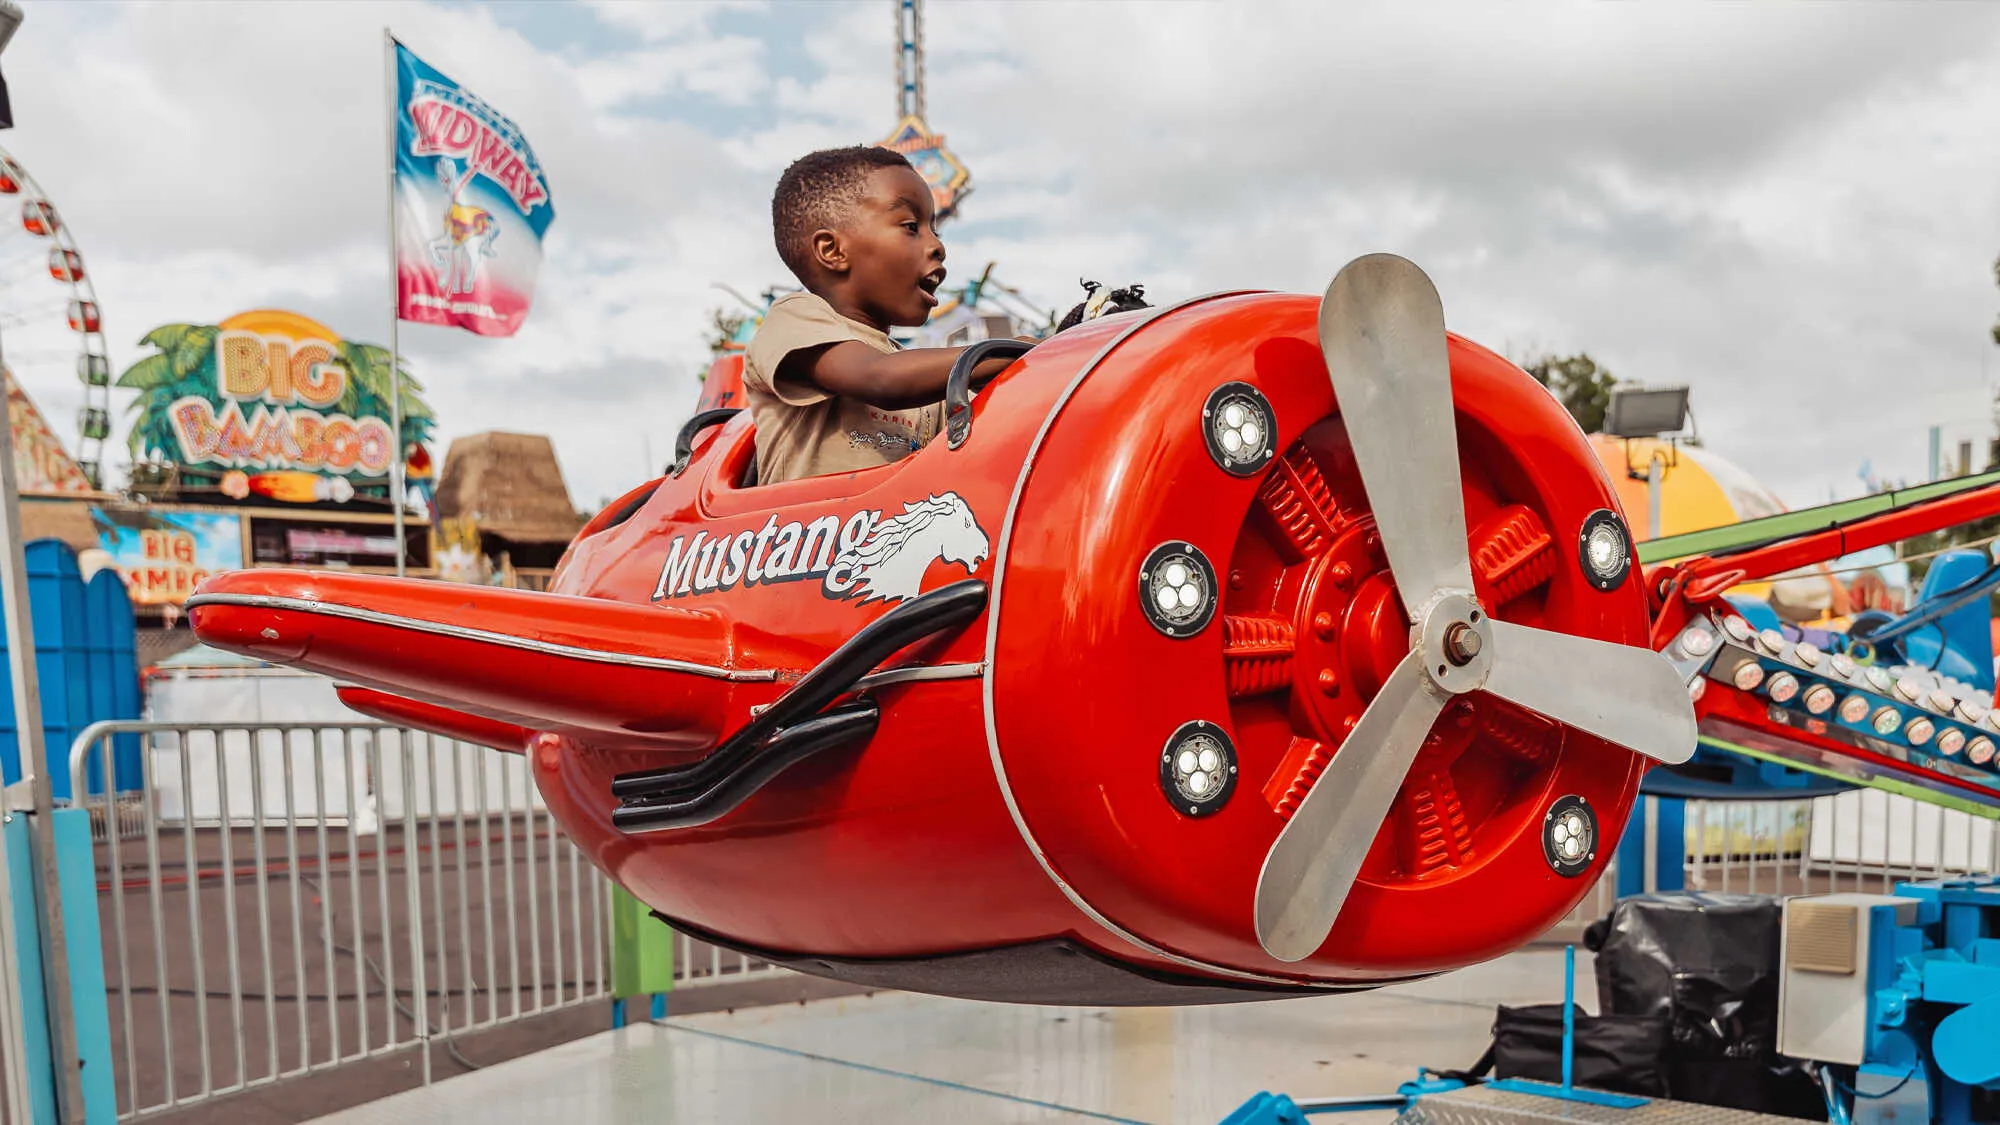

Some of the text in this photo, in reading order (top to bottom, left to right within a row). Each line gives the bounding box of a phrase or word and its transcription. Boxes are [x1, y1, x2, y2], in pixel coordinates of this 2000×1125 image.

[219, 331, 344, 407] BIG
[171, 399, 393, 474] BAMBOO
[145, 534, 195, 565] BIG
[651, 510, 881, 599] Mustang
